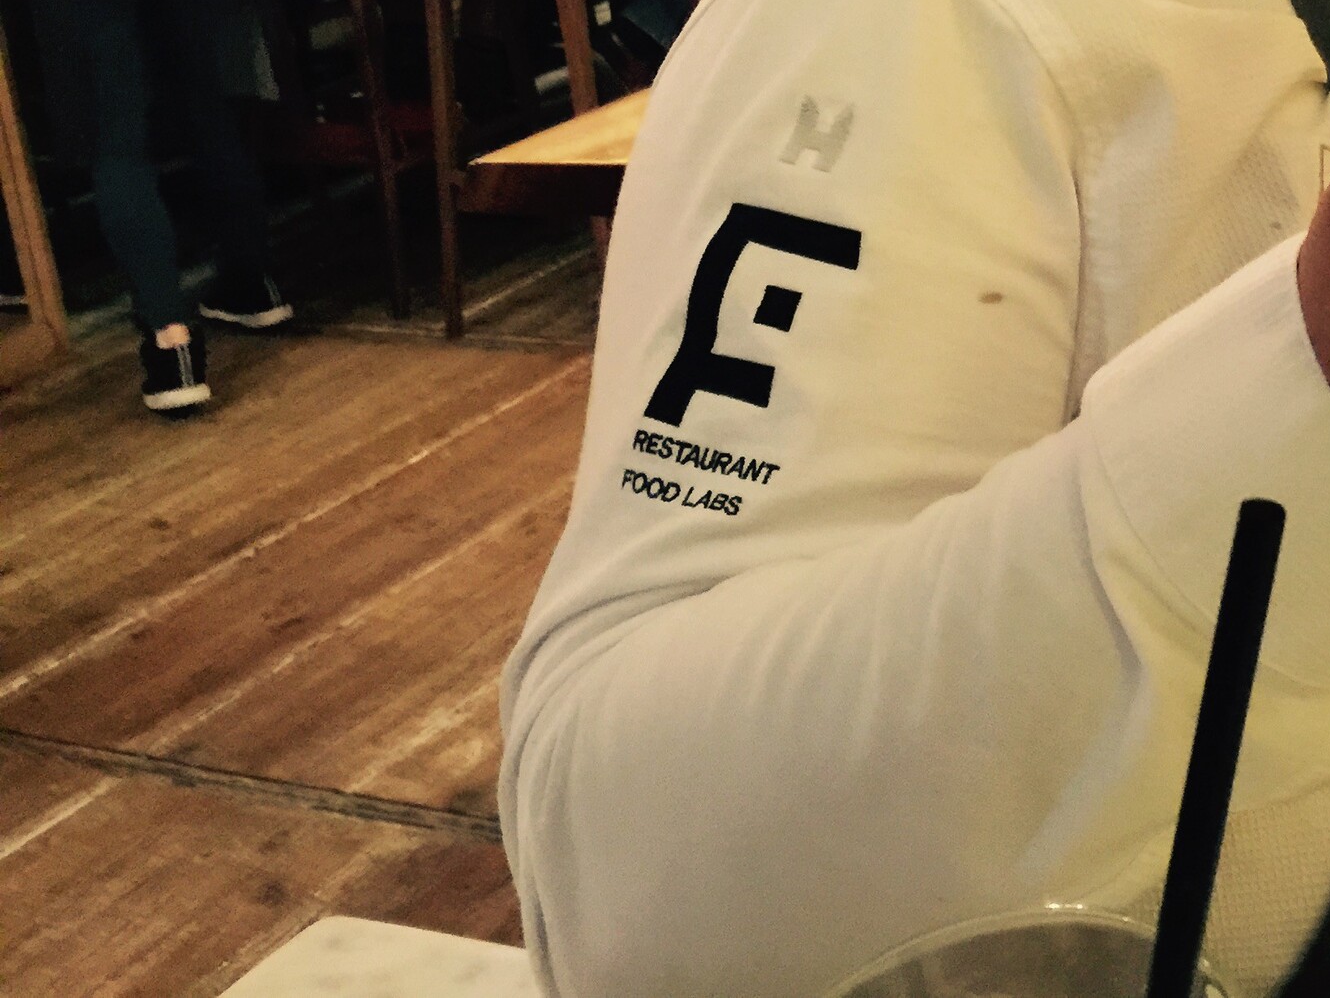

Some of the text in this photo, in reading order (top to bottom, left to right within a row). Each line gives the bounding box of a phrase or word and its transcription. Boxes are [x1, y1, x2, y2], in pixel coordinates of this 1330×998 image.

[632, 428, 780, 485] RESTAURANT
[621, 468, 743, 516] FOOD LABS
